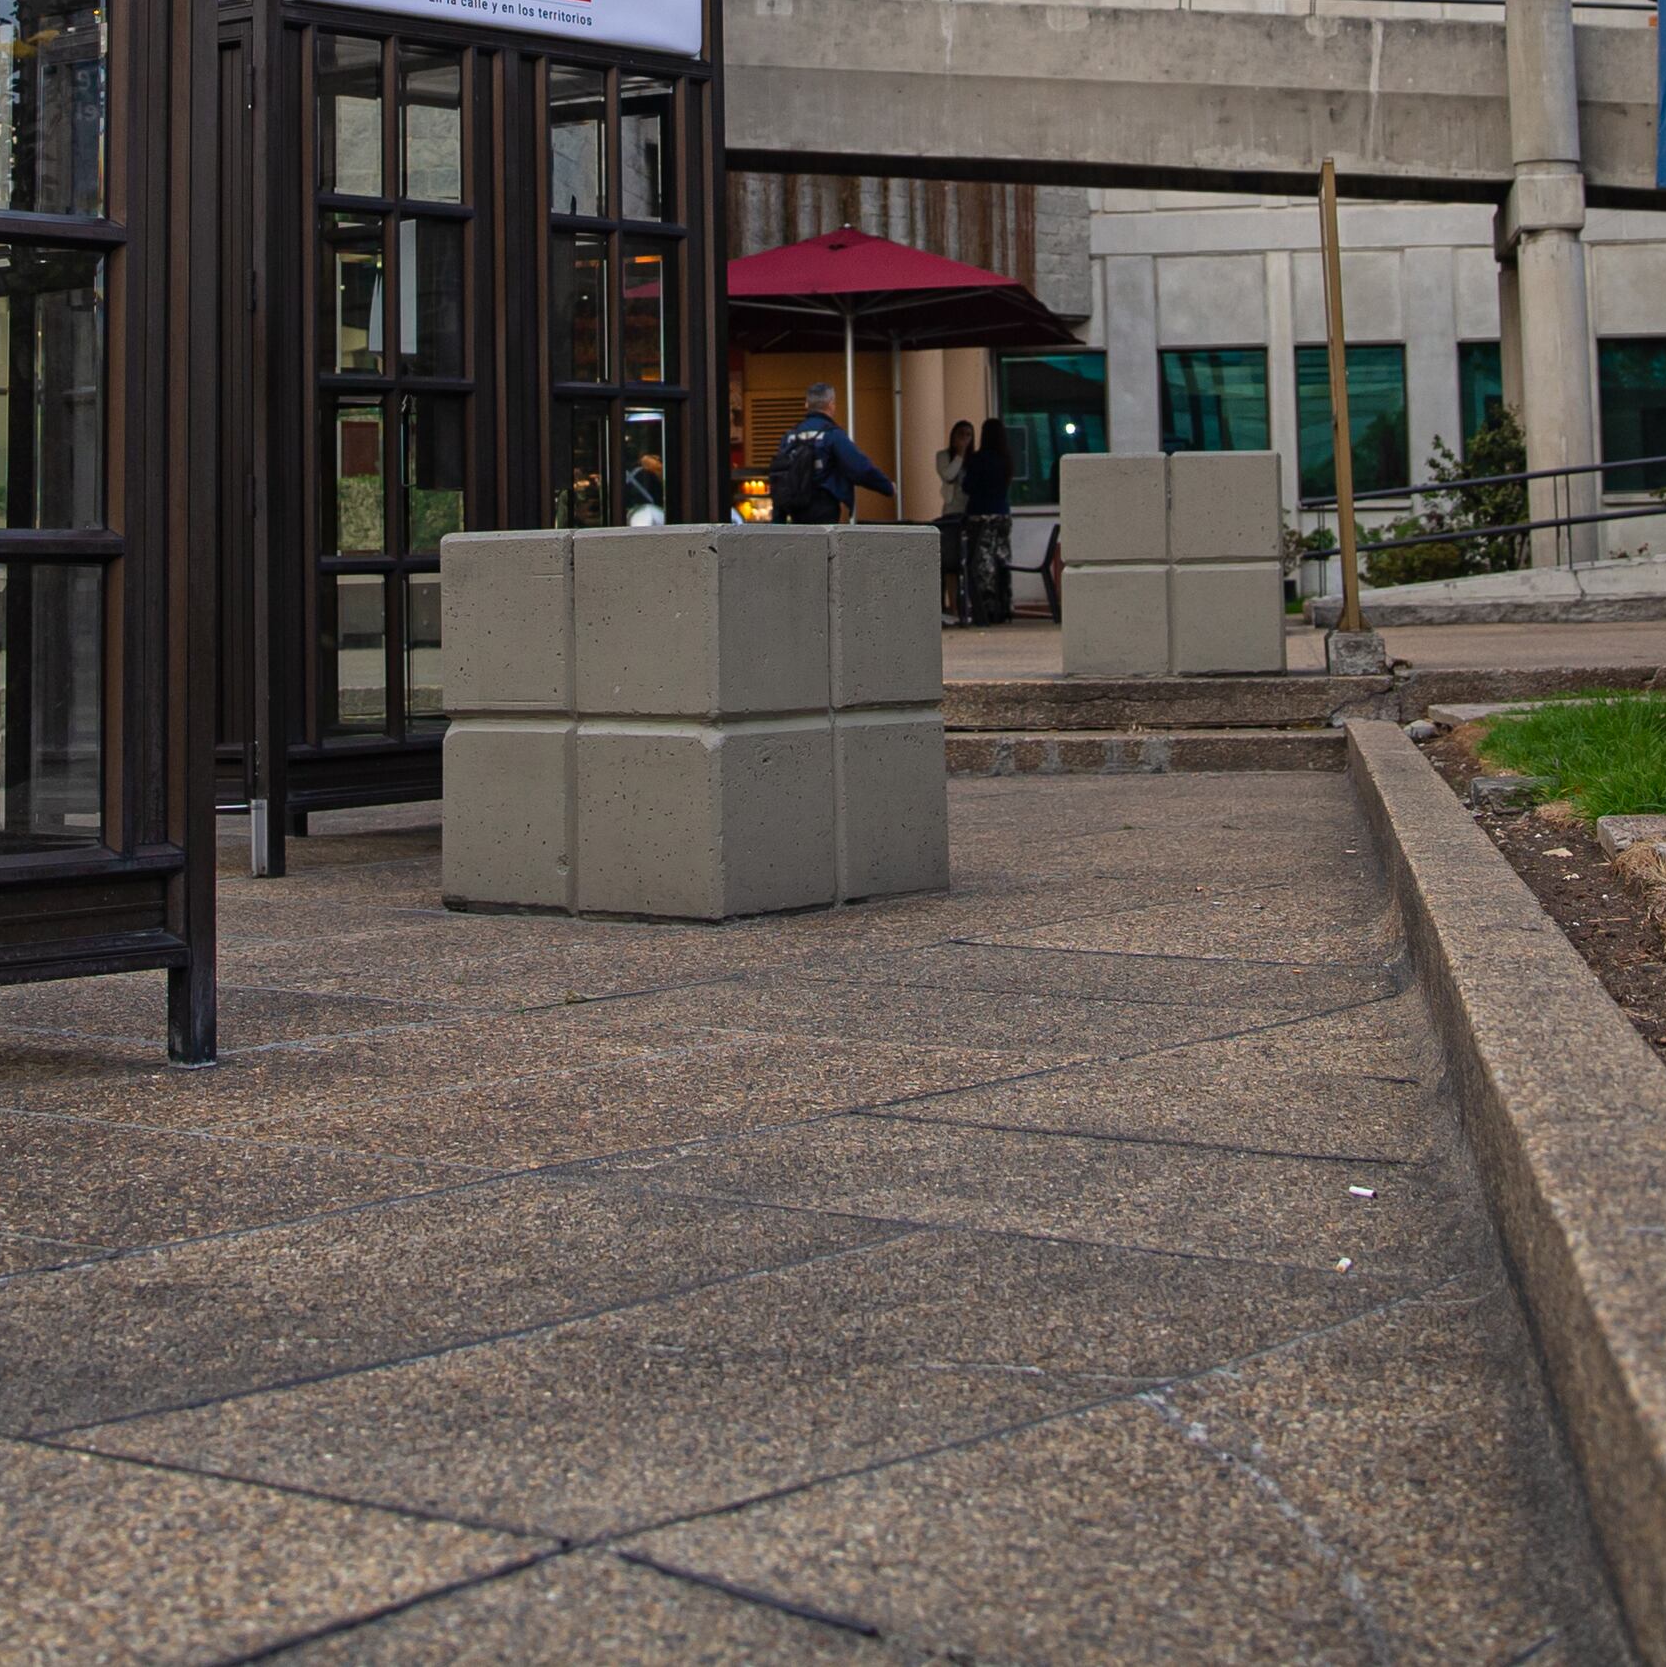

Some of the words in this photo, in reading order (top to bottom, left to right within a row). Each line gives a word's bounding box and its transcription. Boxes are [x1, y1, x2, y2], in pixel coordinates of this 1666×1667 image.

[492, 2, 498, 14] y
[501, 3, 514, 14] en
[518, 3, 535, 17] los
[538, 8, 593, 26] territorios
